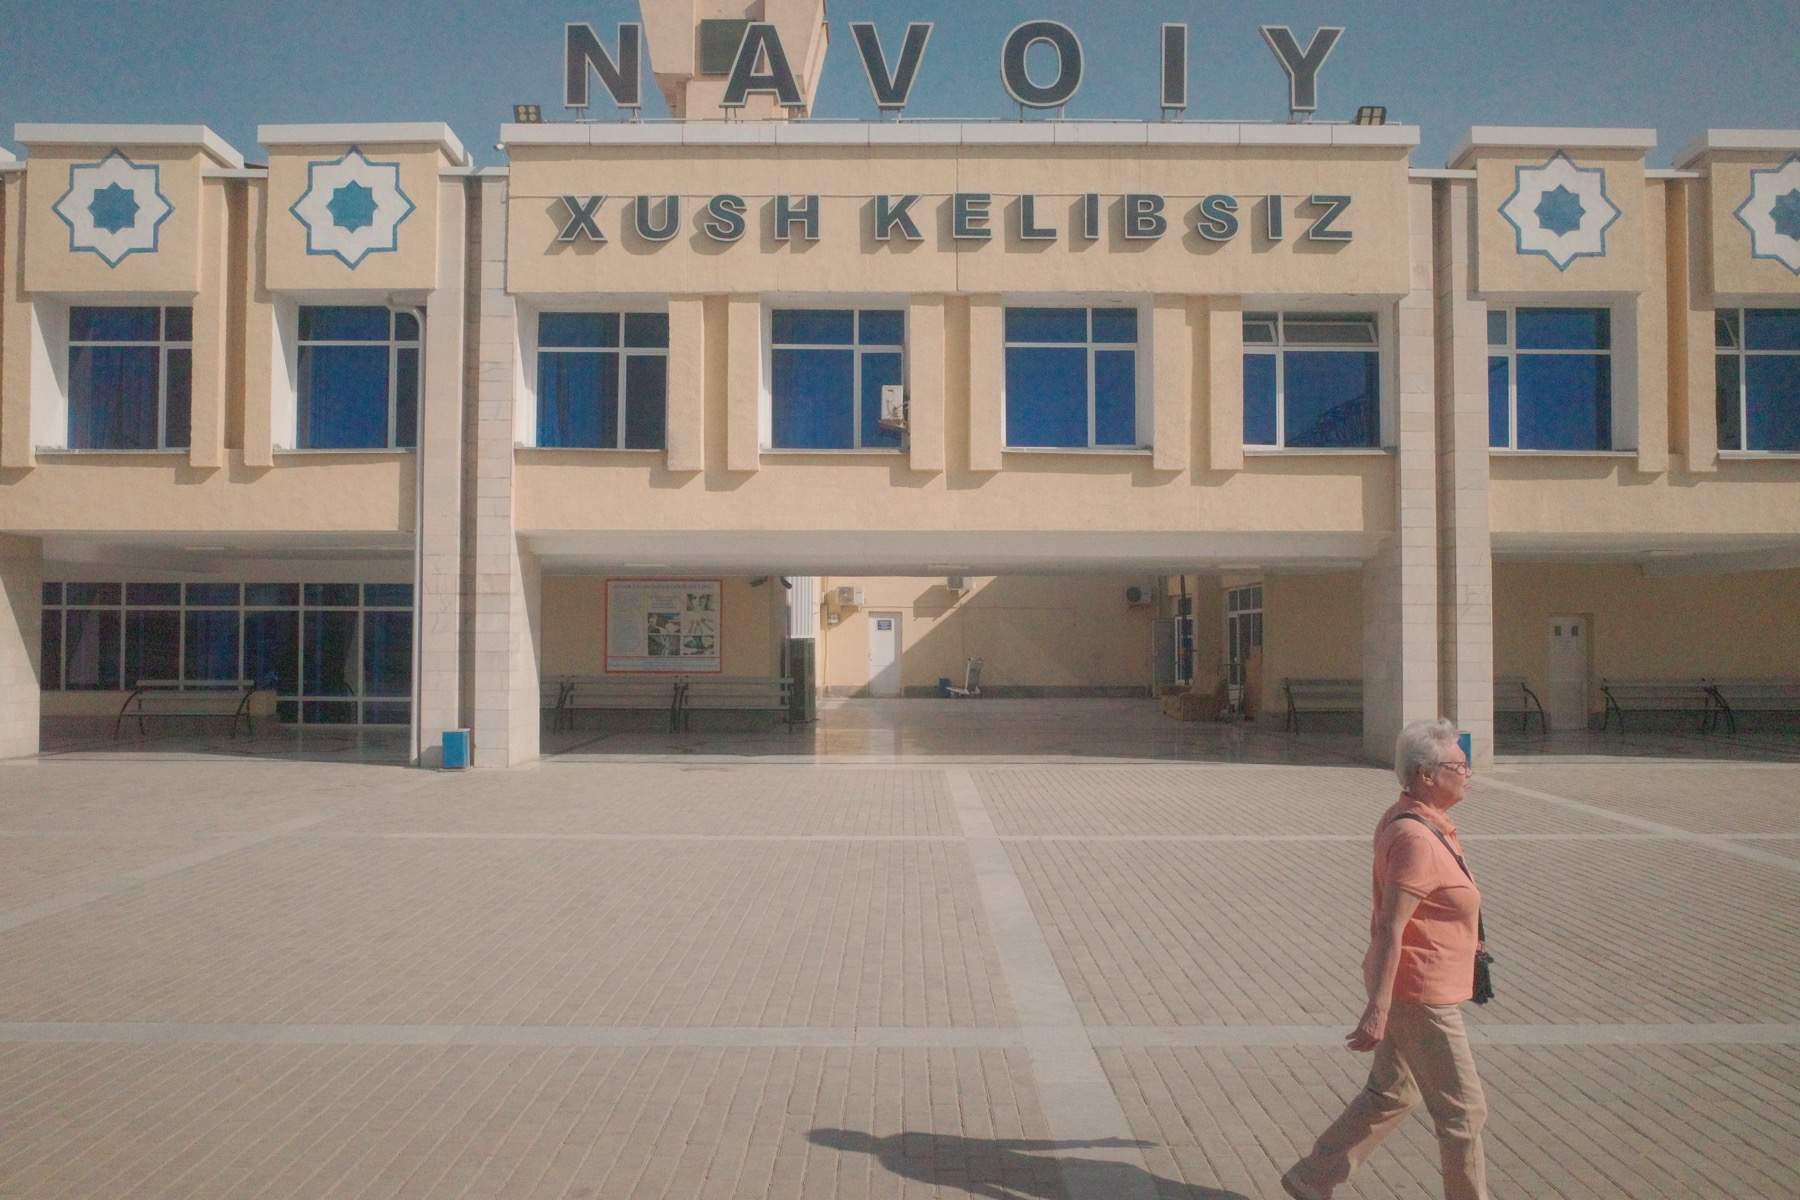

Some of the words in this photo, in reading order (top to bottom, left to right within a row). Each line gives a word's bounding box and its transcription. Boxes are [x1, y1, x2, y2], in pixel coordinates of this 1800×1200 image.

[564, 19, 1346, 112] NAVOIY
[557, 193, 821, 242] XUSH
[874, 192, 1353, 242] KELIBSIZ
